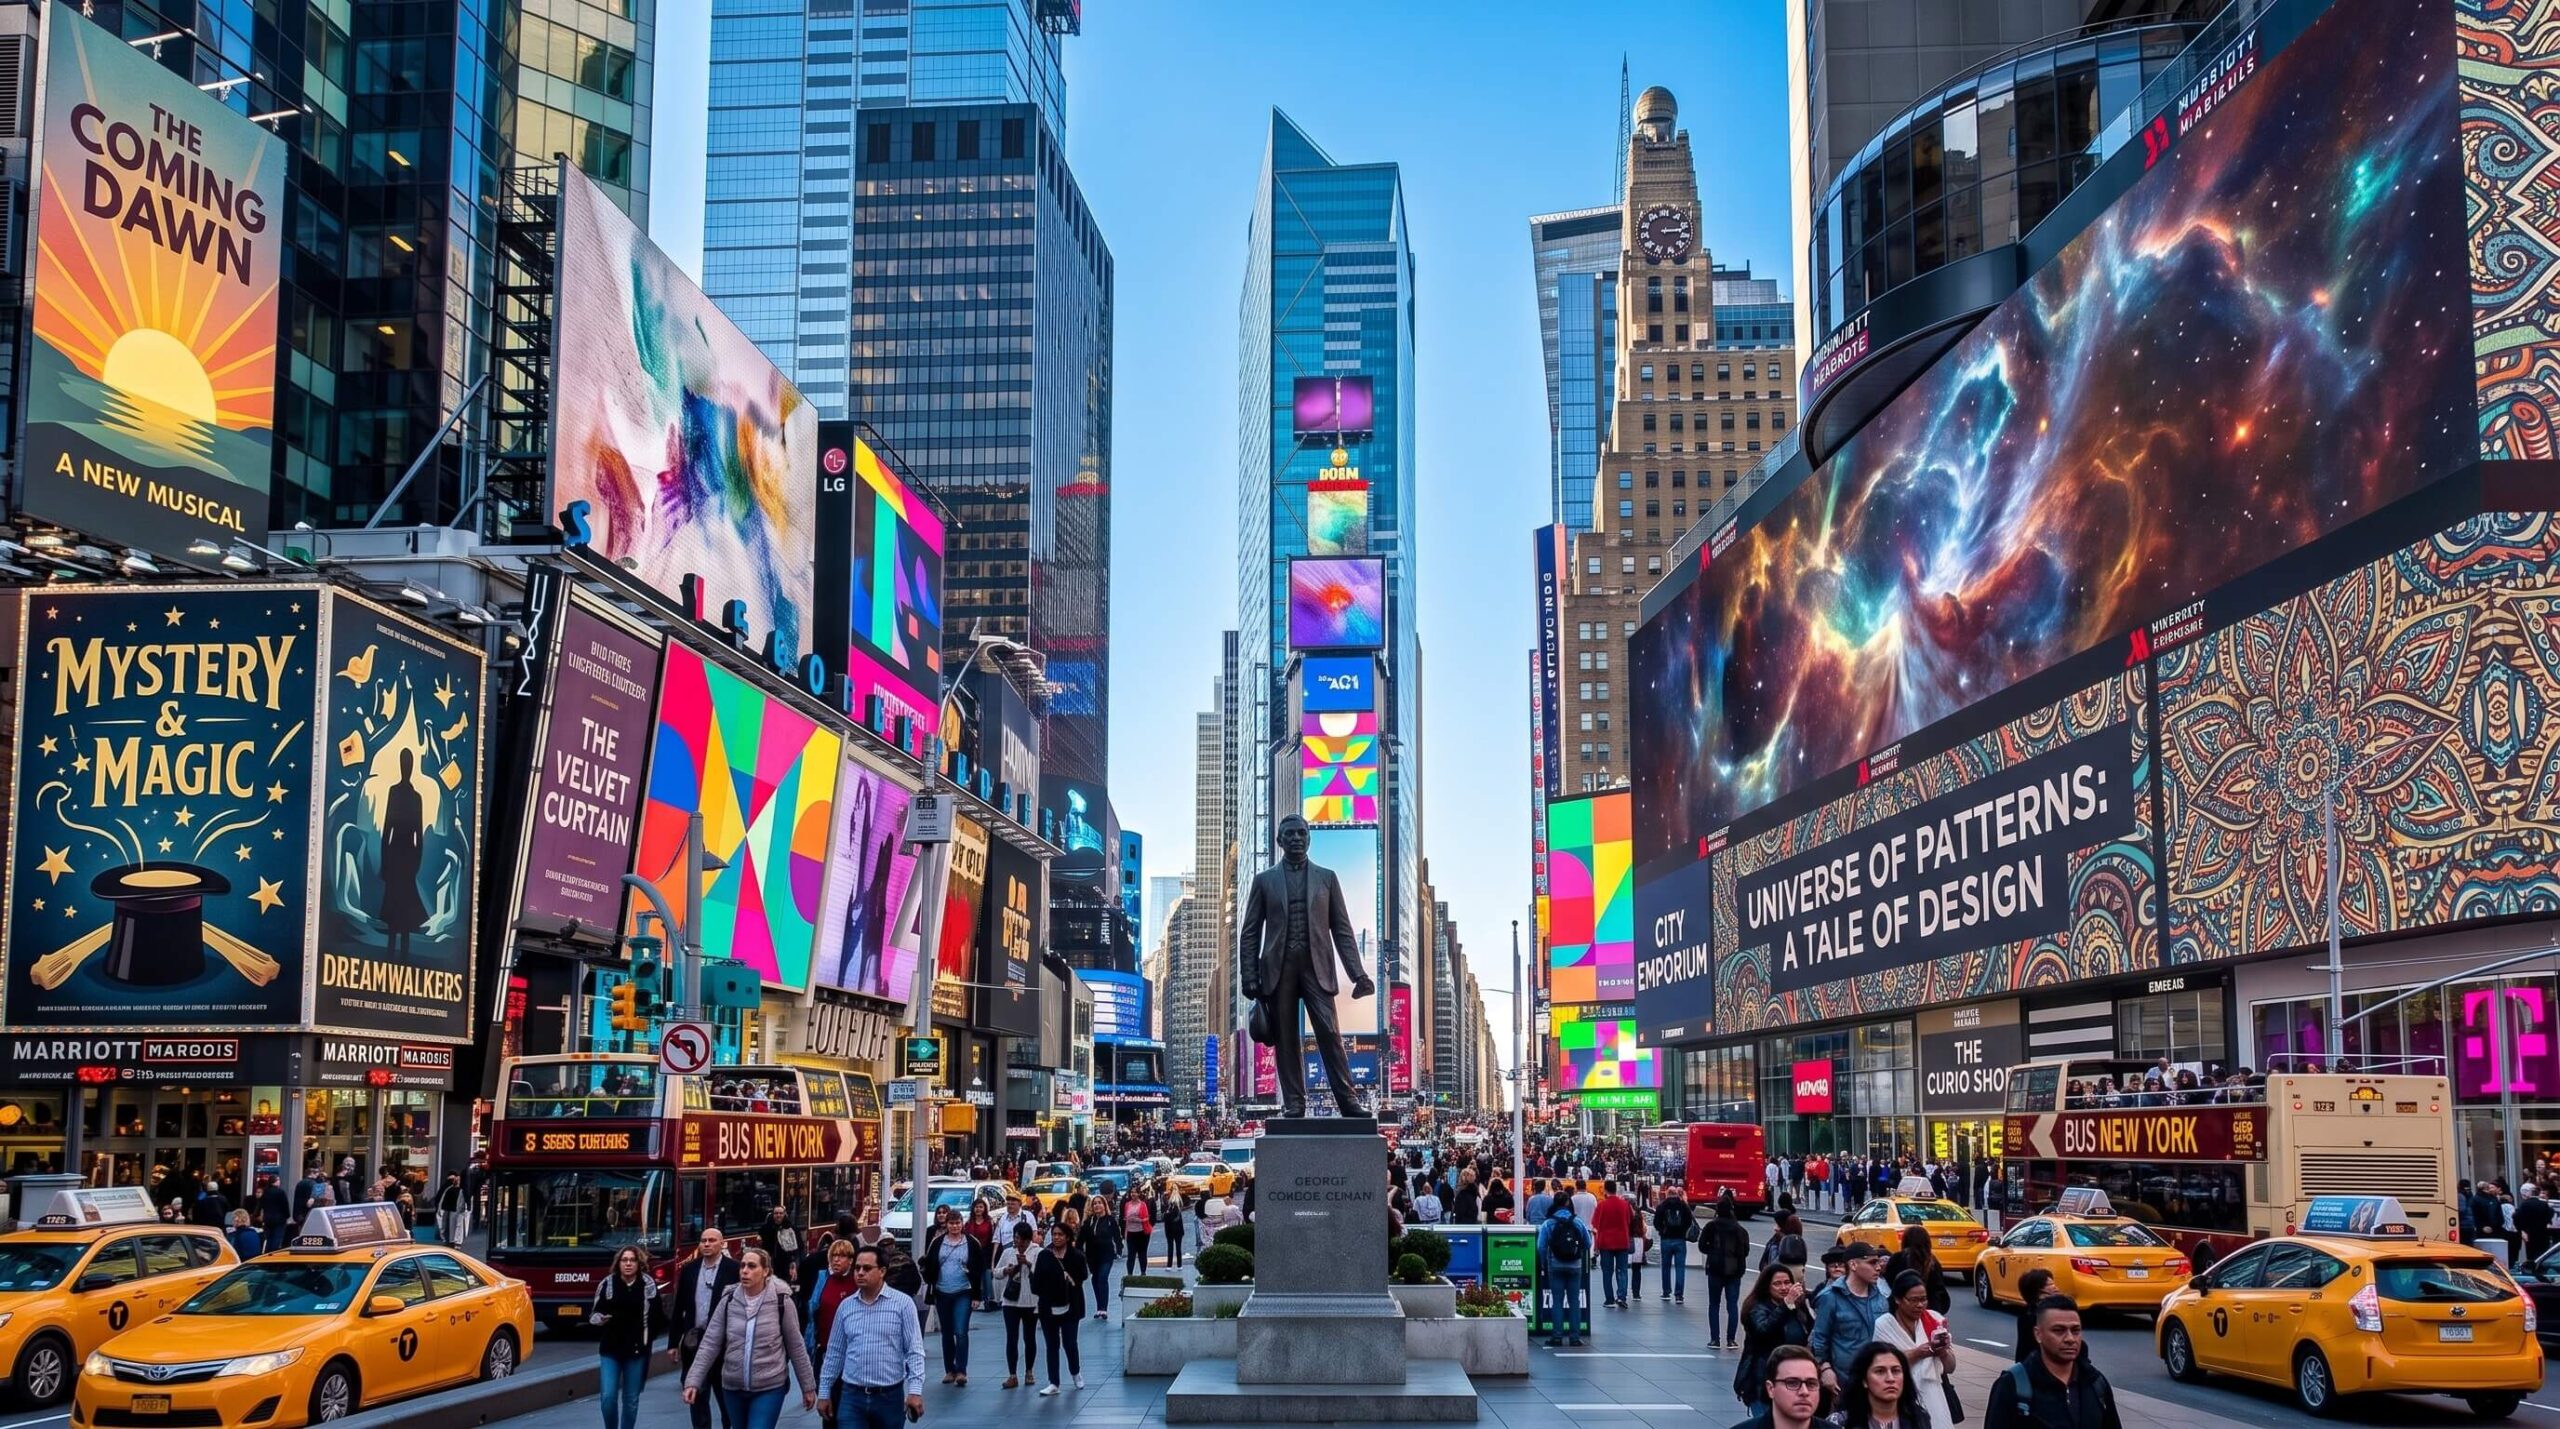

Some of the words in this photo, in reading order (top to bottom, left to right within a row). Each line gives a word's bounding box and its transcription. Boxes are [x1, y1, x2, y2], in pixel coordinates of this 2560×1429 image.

[149, 103, 202, 156] THE
[70, 103, 267, 234] COMING
[83, 159, 252, 287] DAWN
[55, 452, 75, 479] A
[82, 462, 141, 499] NEW
[147, 482, 246, 532] MUSICAL
[823, 477, 846, 492] LG
[46, 635, 297, 716] MYSTERY
[155, 700, 187, 737] &
[581, 716, 620, 762] THE
[91, 737, 255, 808] MAGIC
[557, 750, 631, 806] VELVET
[543, 791, 630, 847] CURTAIN
[1748, 851, 1862, 930] UNIVERSE
[1869, 833, 1906, 883] OF
[1917, 765, 2107, 871] PATTERNS:
[1655, 909, 1686, 947] CITY
[1782, 934, 1799, 972] A
[1803, 909, 1863, 965] TALE
[1872, 900, 1909, 949] OF
[1919, 854, 2045, 938] DESIGN
[323, 952, 463, 1002] DREAMWALKERS
[1638, 943, 1708, 991] EMPORIUM
[13, 1042, 141, 1060] MARRIOTT
[323, 1042, 400, 1065] MARRIOTT
[1954, 1039, 1983, 1065] THE
[1927, 1070, 1970, 1096] CURIO
[719, 1121, 750, 1160] BUS
[754, 1124, 788, 1159] NEW
[789, 1125, 825, 1158] YORK
[2065, 1119, 2096, 1153] BUS
[2100, 1118, 2140, 1152] NEW
[2145, 1117, 2199, 1154] YORK
